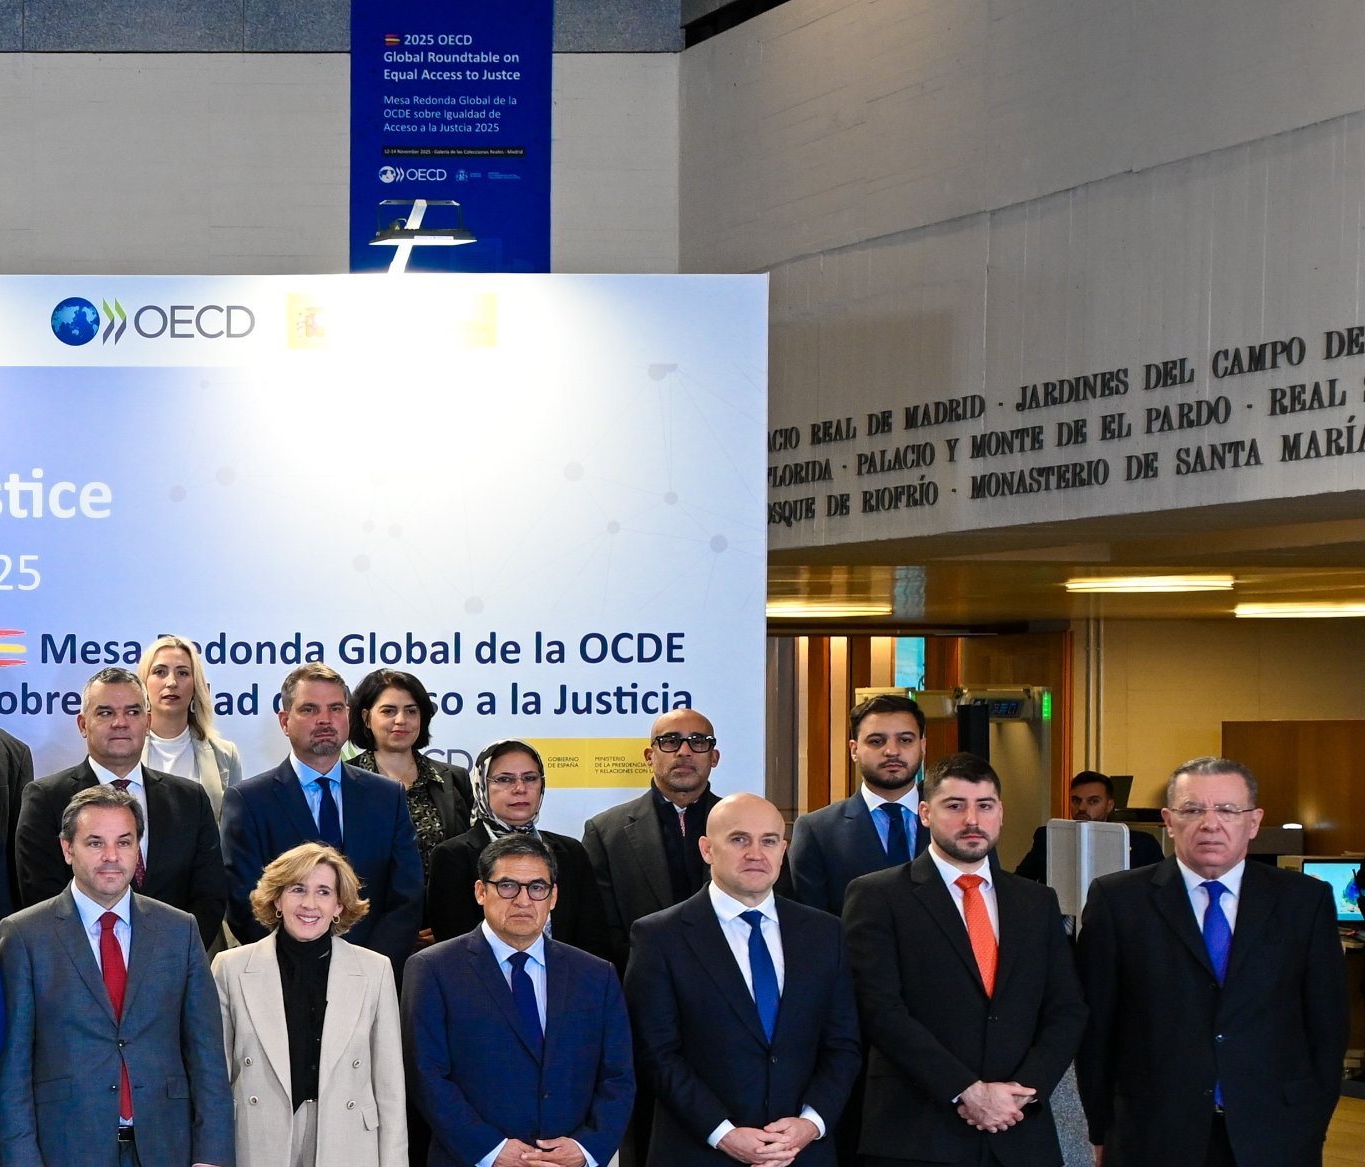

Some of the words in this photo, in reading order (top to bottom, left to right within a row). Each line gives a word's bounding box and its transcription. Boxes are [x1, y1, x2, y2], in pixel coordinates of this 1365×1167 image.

[404, 34, 434, 45] 2025
[438, 34, 472, 45] OECD
[383, 51, 424, 62] Global
[428, 51, 500, 63] Roundtable
[503, 54, 519, 63] on
[384, 69, 417, 82] Equal
[421, 69, 462, 80] Access
[466, 70, 479, 80] to
[384, 96, 410, 105] Mesa
[413, 96, 456, 105] Redonda
[459, 96, 490, 105] Global
[493, 96, 506, 105] de
[508, 96, 517, 105] la
[383, 109, 411, 118] OCDE
[414, 109, 441, 119] sobre
[444, 109, 486, 120] Igualdad
[488, 109, 501, 119] de
[383, 123, 418, 132] Acceso
[428, 122, 437, 132] la
[475, 123, 499, 132] 2025
[406, 168, 448, 181] OECD
[134, 305, 256, 338] OECD
[810, 417, 856, 446] REAL
[867, 410, 893, 436] DE
[904, 394, 986, 430] MADRID
[1016, 368, 1129, 411] JARDINES
[1144, 357, 1195, 390] DEL
[1212, 336, 1306, 378] CAMPO
[856, 442, 936, 476] PALACIO
[945, 438, 959, 463] Y
[970, 425, 1044, 459] MONTE
[1057, 419, 1087, 447] DE
[1100, 412, 1132, 441] EL
[1145, 395, 1232, 434] PARDO
[1268, 378, 1346, 416] REAL
[826, 493, 850, 517] DE
[862, 475, 938, 513] RIOFRÍO
[970, 458, 1110, 499] MONASTERIO
[1125, 452, 1159, 481] DE
[1176, 438, 1264, 475] SANTA
[41, 634, 142, 664] Mesa
[338, 632, 461, 664] Global
[474, 632, 520, 664] de
[535, 631, 565, 664] la
[579, 632, 685, 664] OCDE
[476, 691, 496, 715] a
[511, 682, 541, 715] la
[554, 682, 692, 715] Justicia
